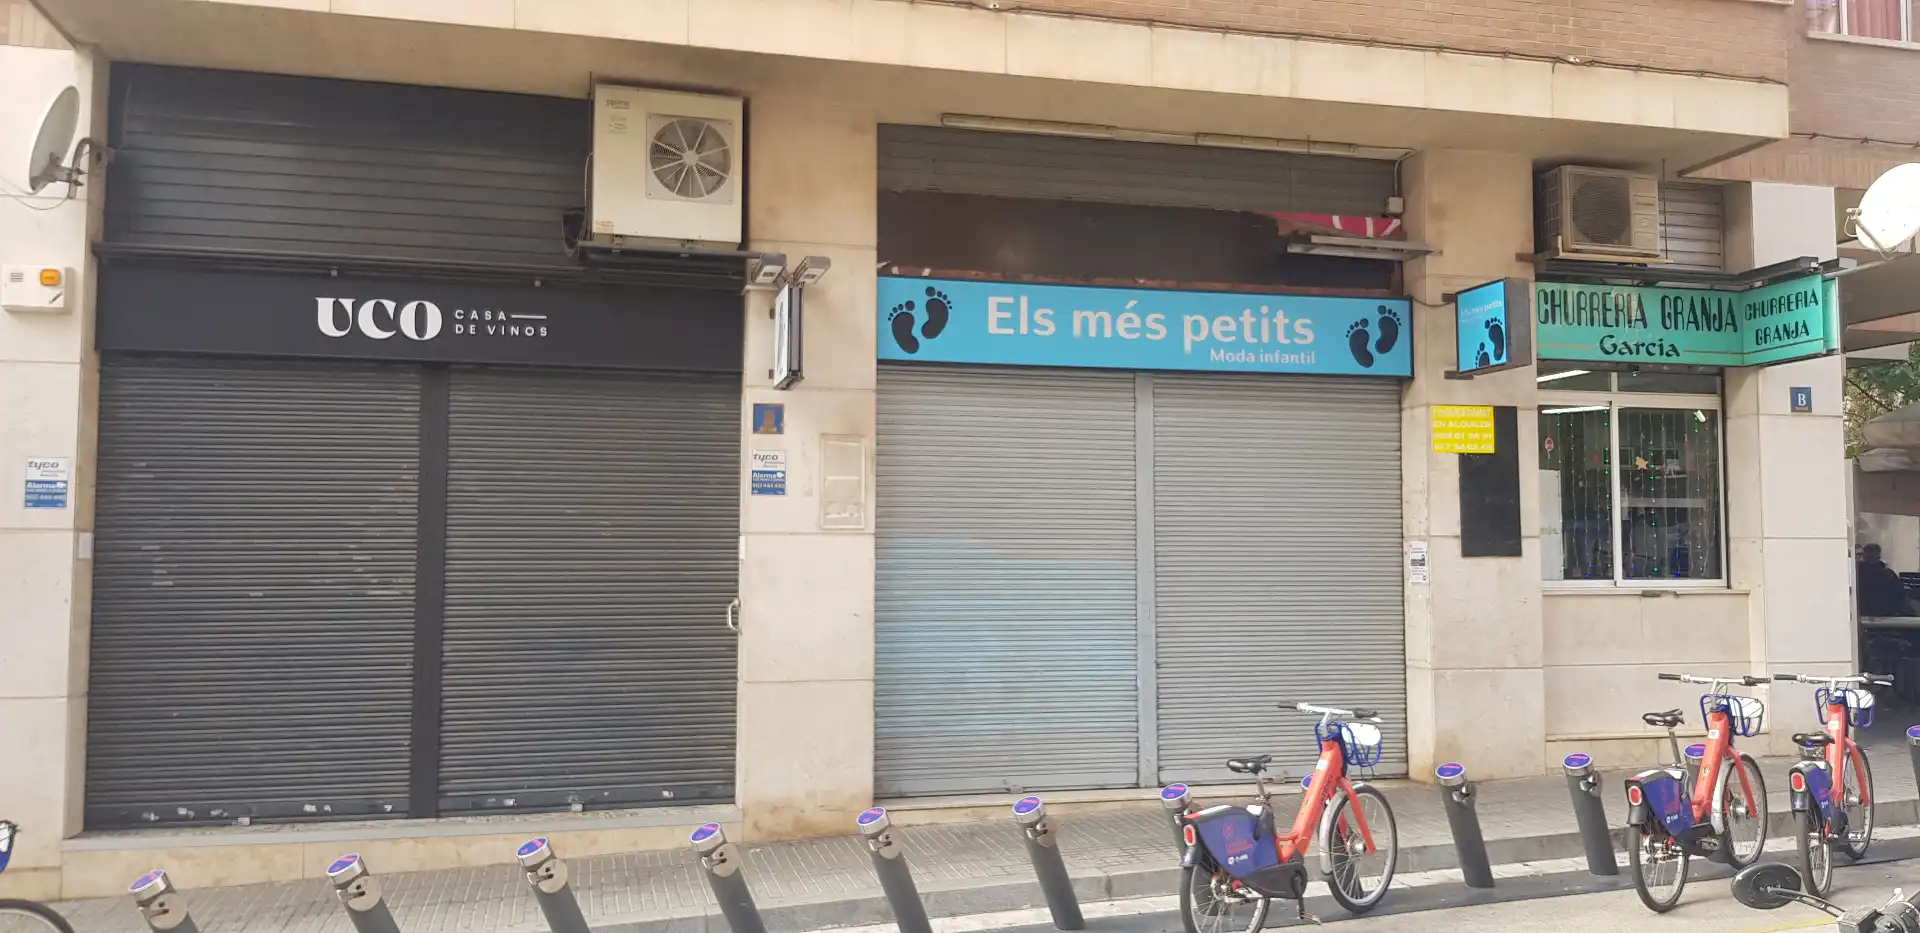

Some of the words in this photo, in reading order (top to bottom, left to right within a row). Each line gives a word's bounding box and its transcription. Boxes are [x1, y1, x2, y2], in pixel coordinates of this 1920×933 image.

[1537, 288, 1648, 329] CHURRERIA
[1661, 294, 1738, 332] GRANJA
[1744, 288, 1819, 321] CHURRERIA
[316, 297, 442, 341] UCO
[454, 309, 507, 321] CASA
[455, 324, 476, 335] DE
[487, 325, 548, 337] VINOS
[988, 295, 1056, 336] Els
[1073, 300, 1167, 340] més
[1183, 305, 1315, 356] petits
[1755, 320, 1810, 345] GRANJA
[1599, 334, 1681, 358] Garcia
[1210, 348, 1255, 363] Moda
[1259, 350, 1316, 365] infantil
[1797, 393, 1807, 407] B
[28, 460, 59, 470] tyco
[753, 453, 779, 462] tyco
